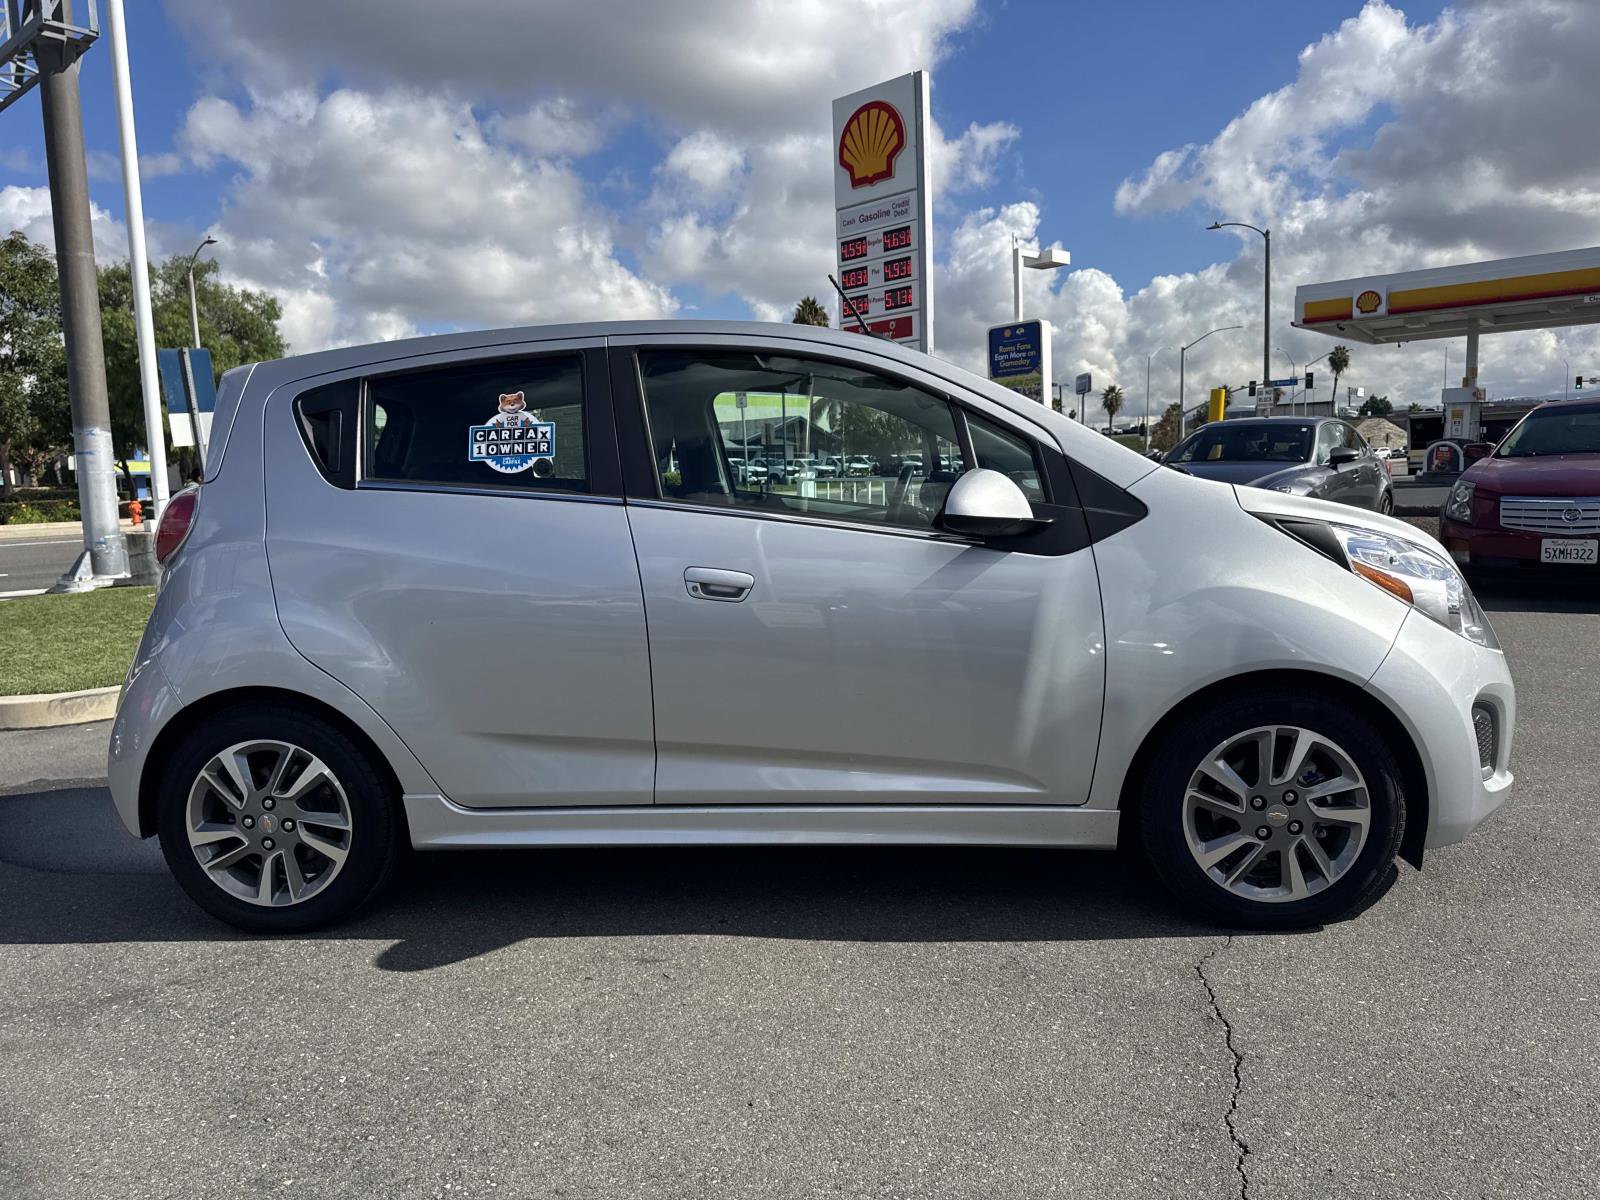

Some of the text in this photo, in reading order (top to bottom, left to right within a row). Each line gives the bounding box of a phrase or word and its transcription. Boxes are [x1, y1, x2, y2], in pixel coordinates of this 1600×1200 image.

[892, 199, 910, 210] Credit
[843, 209, 891, 227] Cash Gasoline
[894, 208, 908, 218] Debit
[999, 343, 1031, 353] Rams Fans
[995, 353, 1009, 361] Earn
[1010, 351, 1027, 359] More
[1000, 358, 1031, 368] Gameday
[476, 429, 549, 441] CARFAX
[476, 442, 549, 455] 1 OWNER
[1544, 547, 1594, 561] 5XMH322
